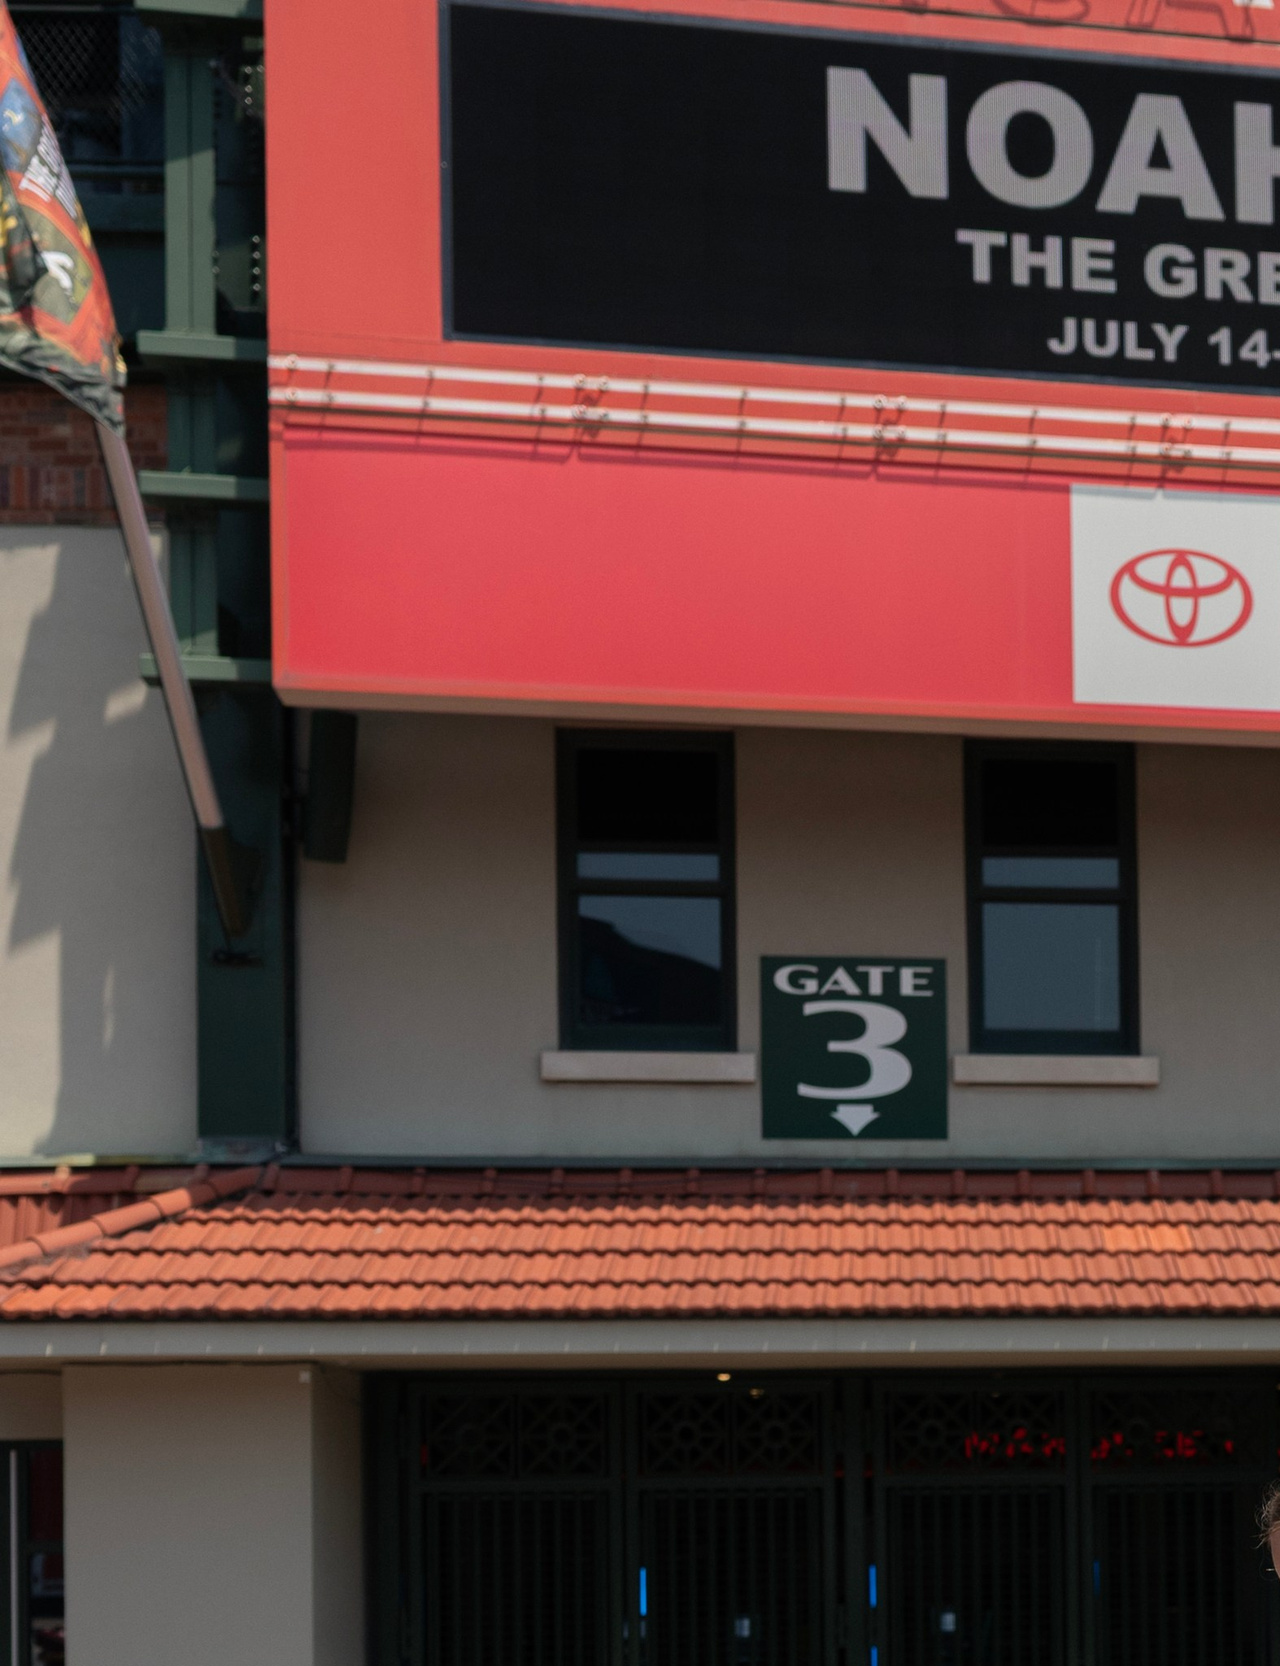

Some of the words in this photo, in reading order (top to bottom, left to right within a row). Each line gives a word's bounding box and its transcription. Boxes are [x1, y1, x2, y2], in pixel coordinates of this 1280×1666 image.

[957, 229, 1115, 293] THE
[1049, 317, 1187, 362] JULY
[774, 964, 933, 996] GATE
[797, 1000, 912, 1100] 3
